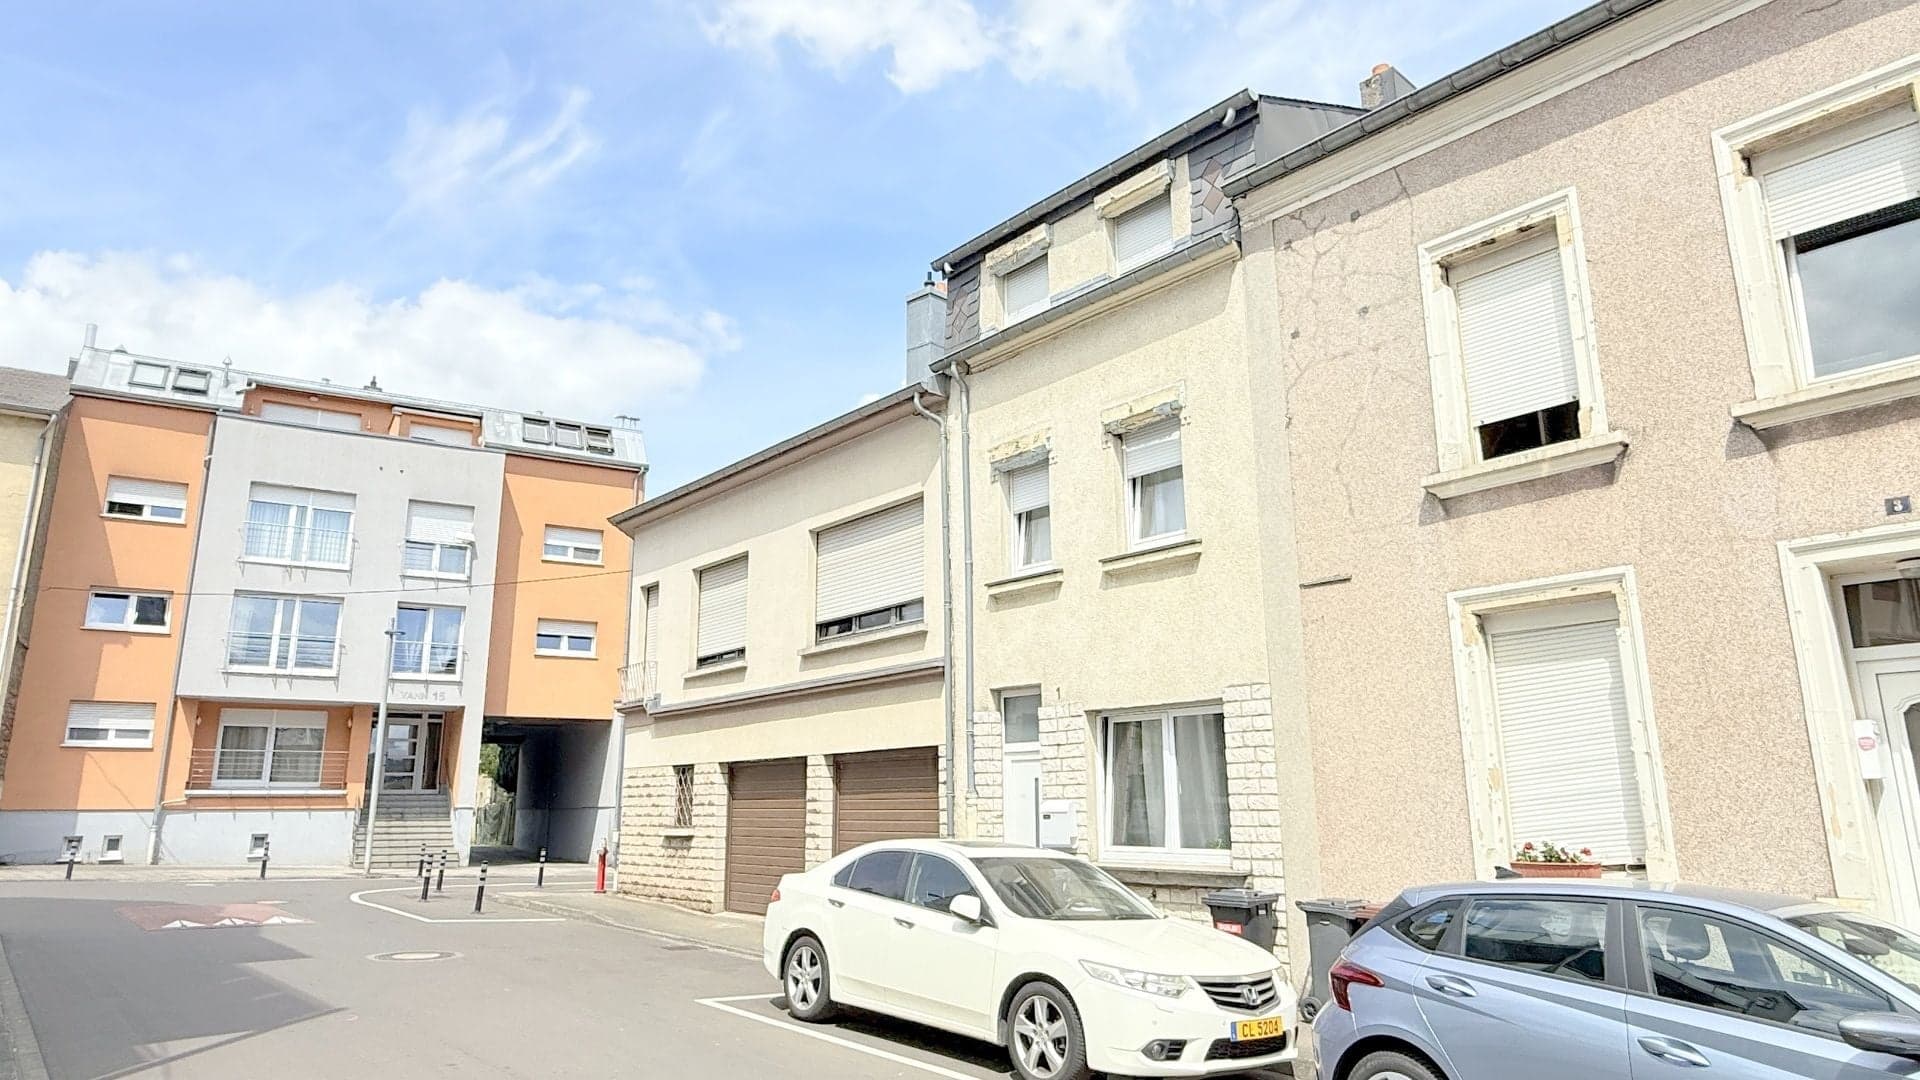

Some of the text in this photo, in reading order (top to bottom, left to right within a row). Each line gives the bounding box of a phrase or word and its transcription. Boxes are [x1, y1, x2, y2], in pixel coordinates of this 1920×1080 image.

[1892, 499, 1903, 512] 3
[432, 691, 446, 702] 15
[1055, 687, 1061, 700] 1
[1242, 1020, 1279, 1037] CL 5204
